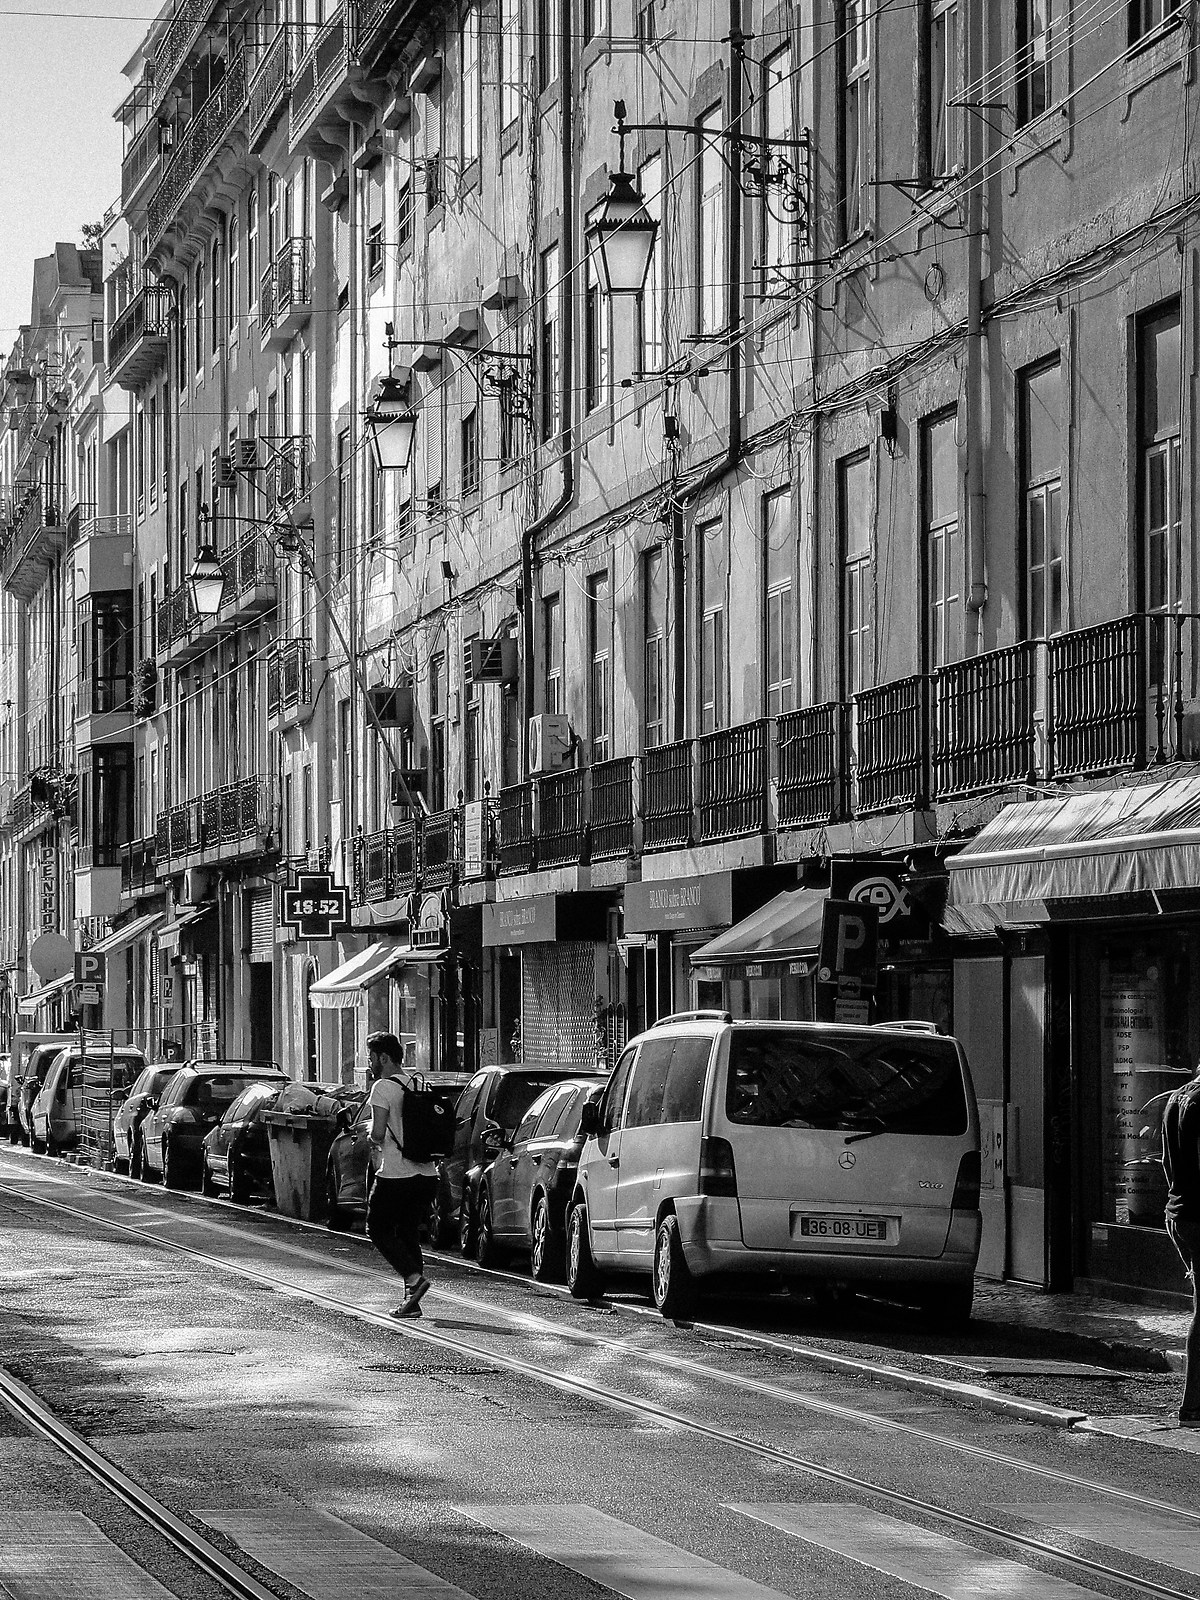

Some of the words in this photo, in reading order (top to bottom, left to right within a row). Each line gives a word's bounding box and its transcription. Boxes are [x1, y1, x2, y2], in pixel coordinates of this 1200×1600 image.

[835, 913, 866, 972] P
[81, 956, 99, 980] P
[167, 1048, 175, 1059] P
